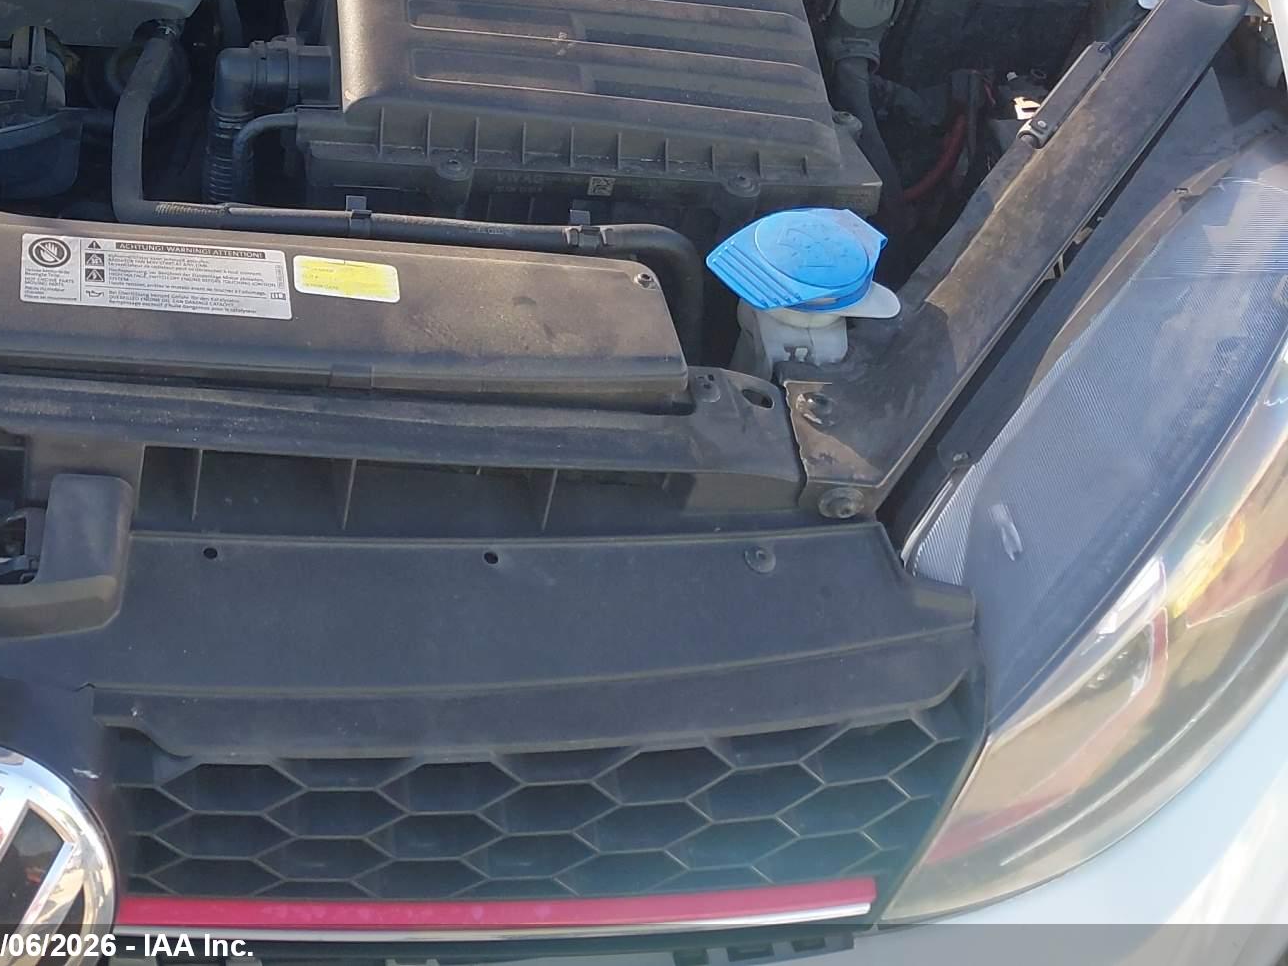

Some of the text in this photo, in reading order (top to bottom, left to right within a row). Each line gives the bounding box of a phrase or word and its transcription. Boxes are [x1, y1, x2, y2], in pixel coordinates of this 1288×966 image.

[119, 243, 263, 259] ACHTUNG! WARNING! ATTENTION!
